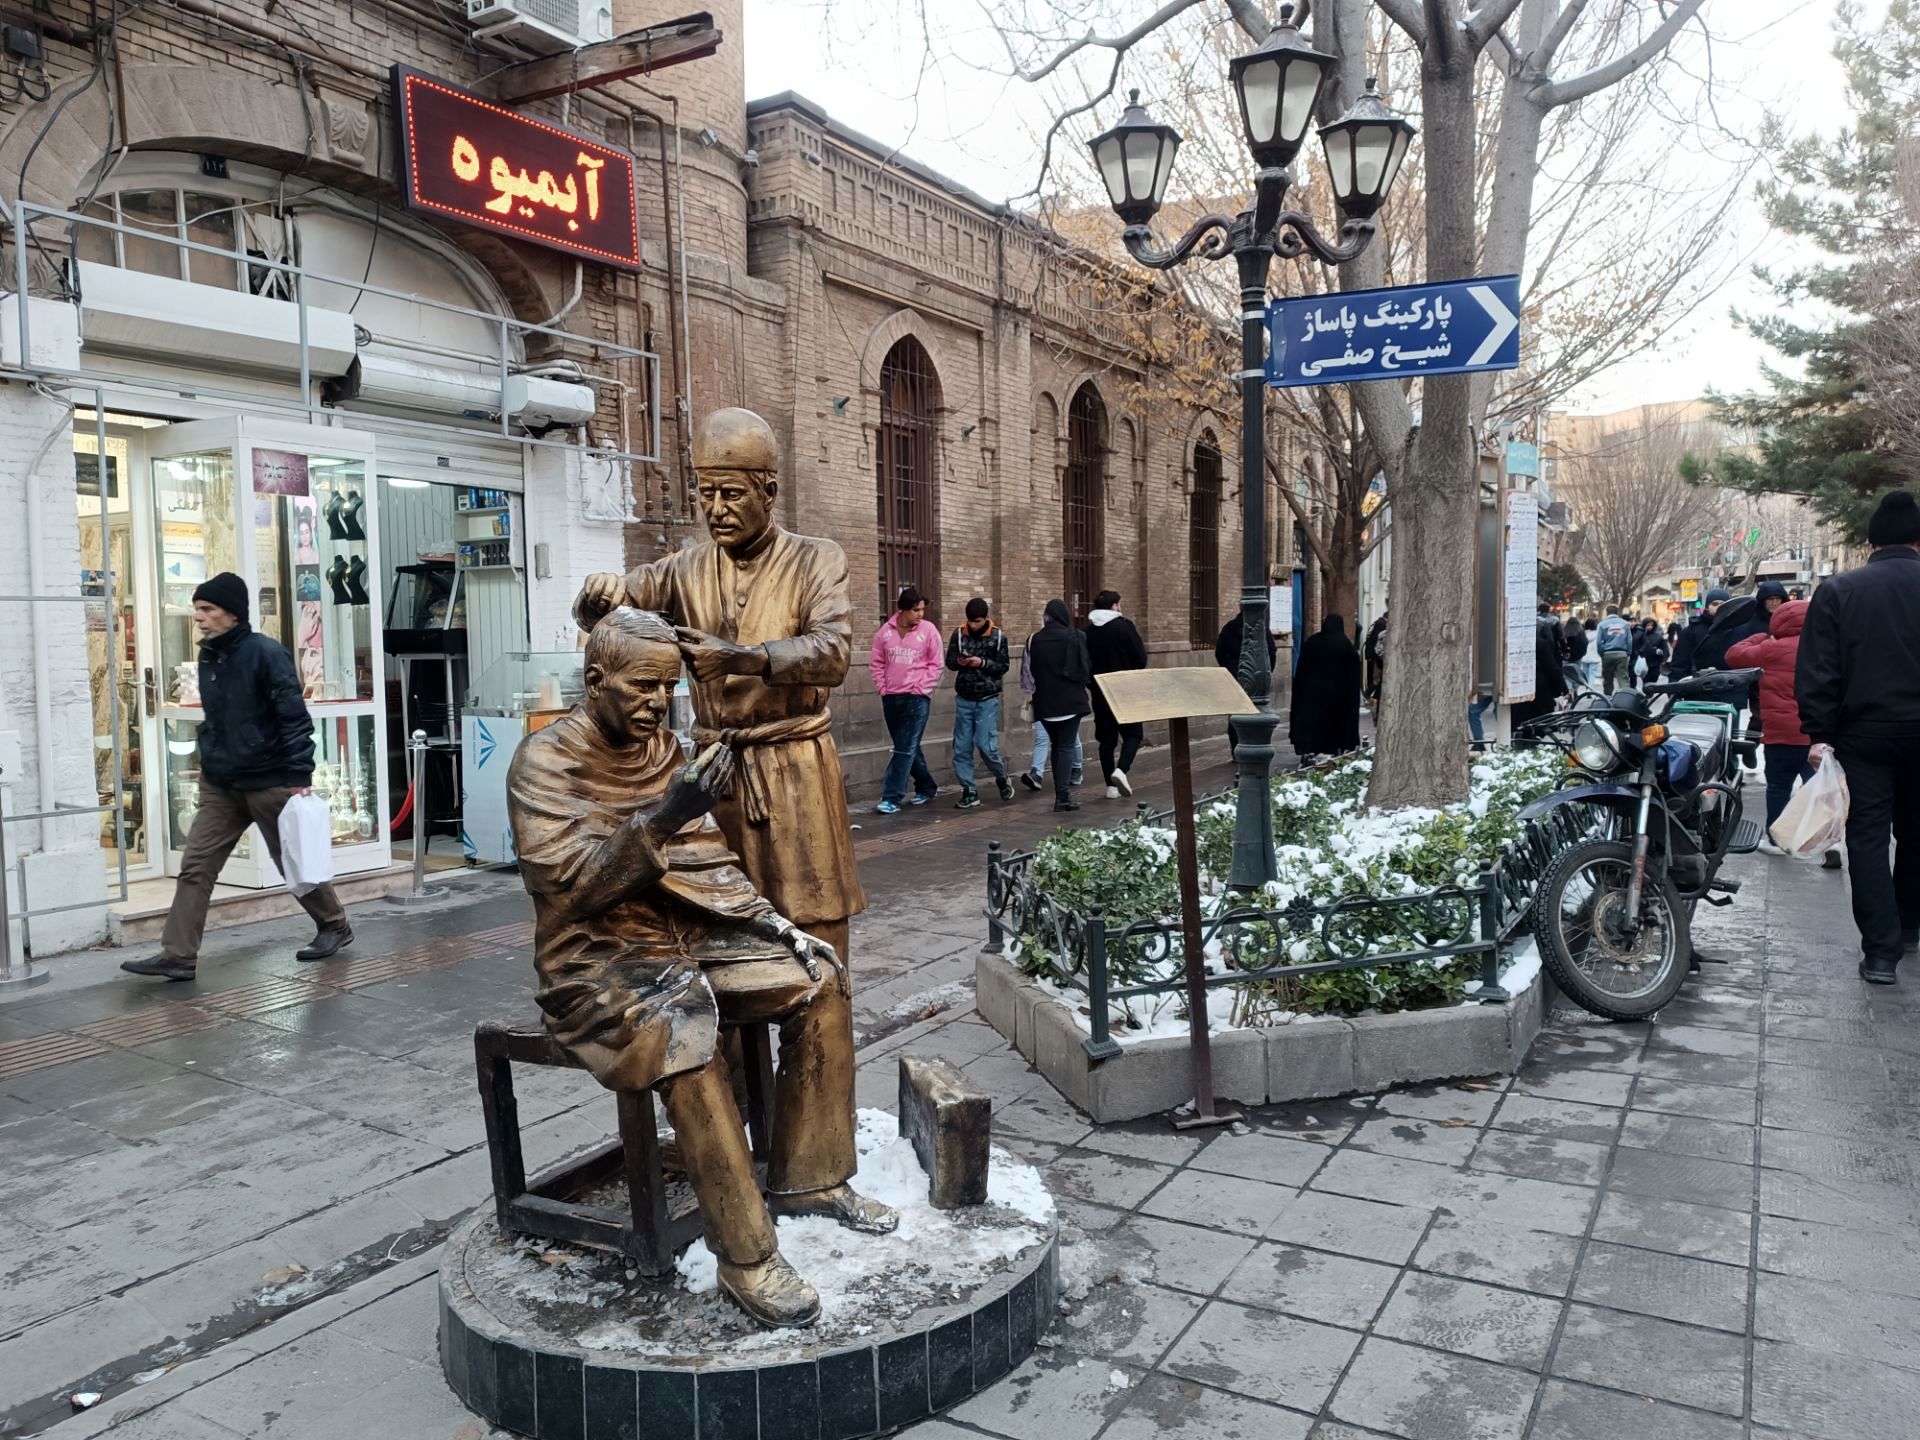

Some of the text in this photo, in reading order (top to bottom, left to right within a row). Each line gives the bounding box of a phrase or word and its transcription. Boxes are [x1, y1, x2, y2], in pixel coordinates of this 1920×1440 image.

[452, 135, 605, 232] آبمیوه
[1301, 295, 1452, 342] پارکینگ پاساژ
[1300, 332, 1452, 378] شیخ صفی
